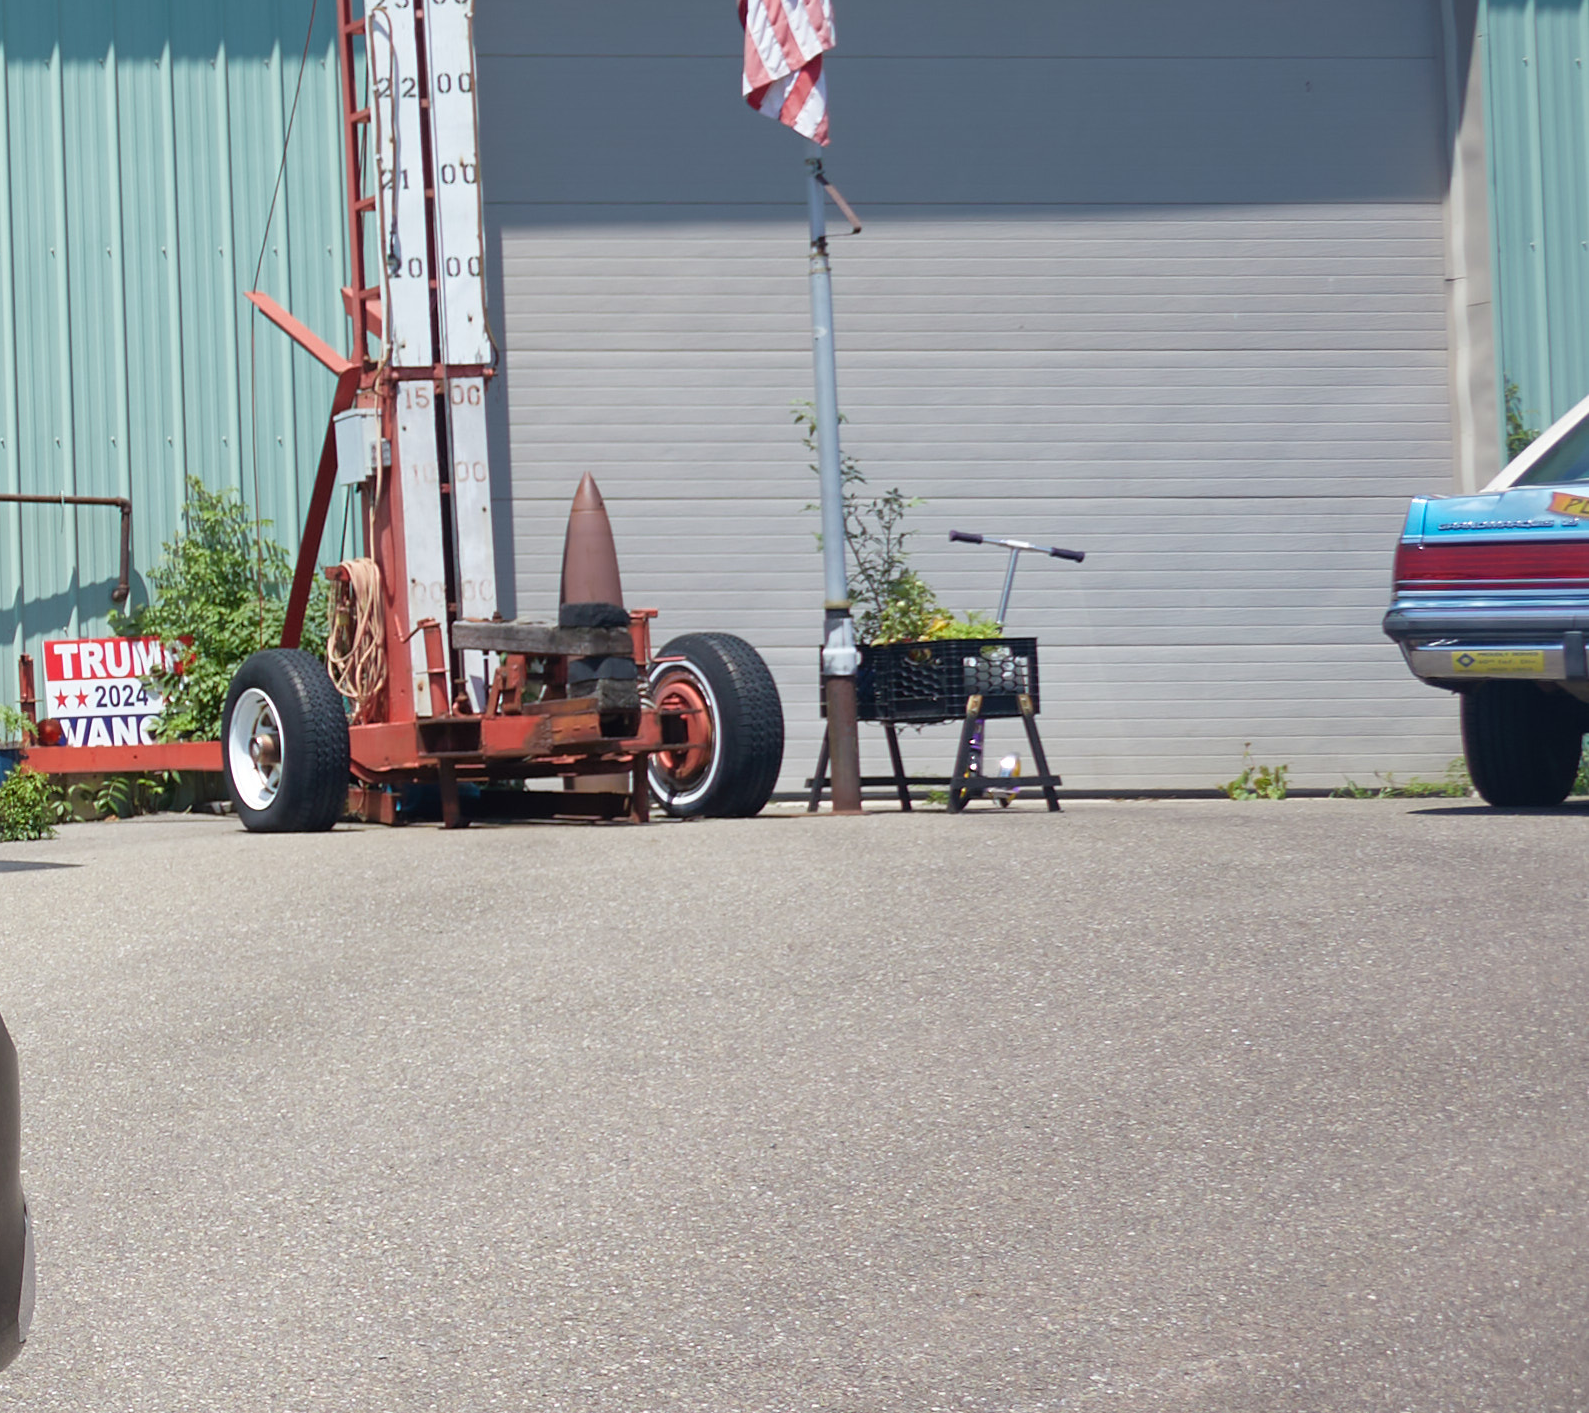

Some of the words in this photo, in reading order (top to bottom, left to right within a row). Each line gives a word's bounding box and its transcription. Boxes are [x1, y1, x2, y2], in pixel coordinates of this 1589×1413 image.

[377, 76, 417, 98] 22
[388, 257, 423, 278] 0
[446, 256, 482, 277] 00
[405, 386, 431, 409] 15
[451, 384, 481, 406] 00
[94, 684, 149, 708] 2024
[60, 715, 162, 748] VANC
